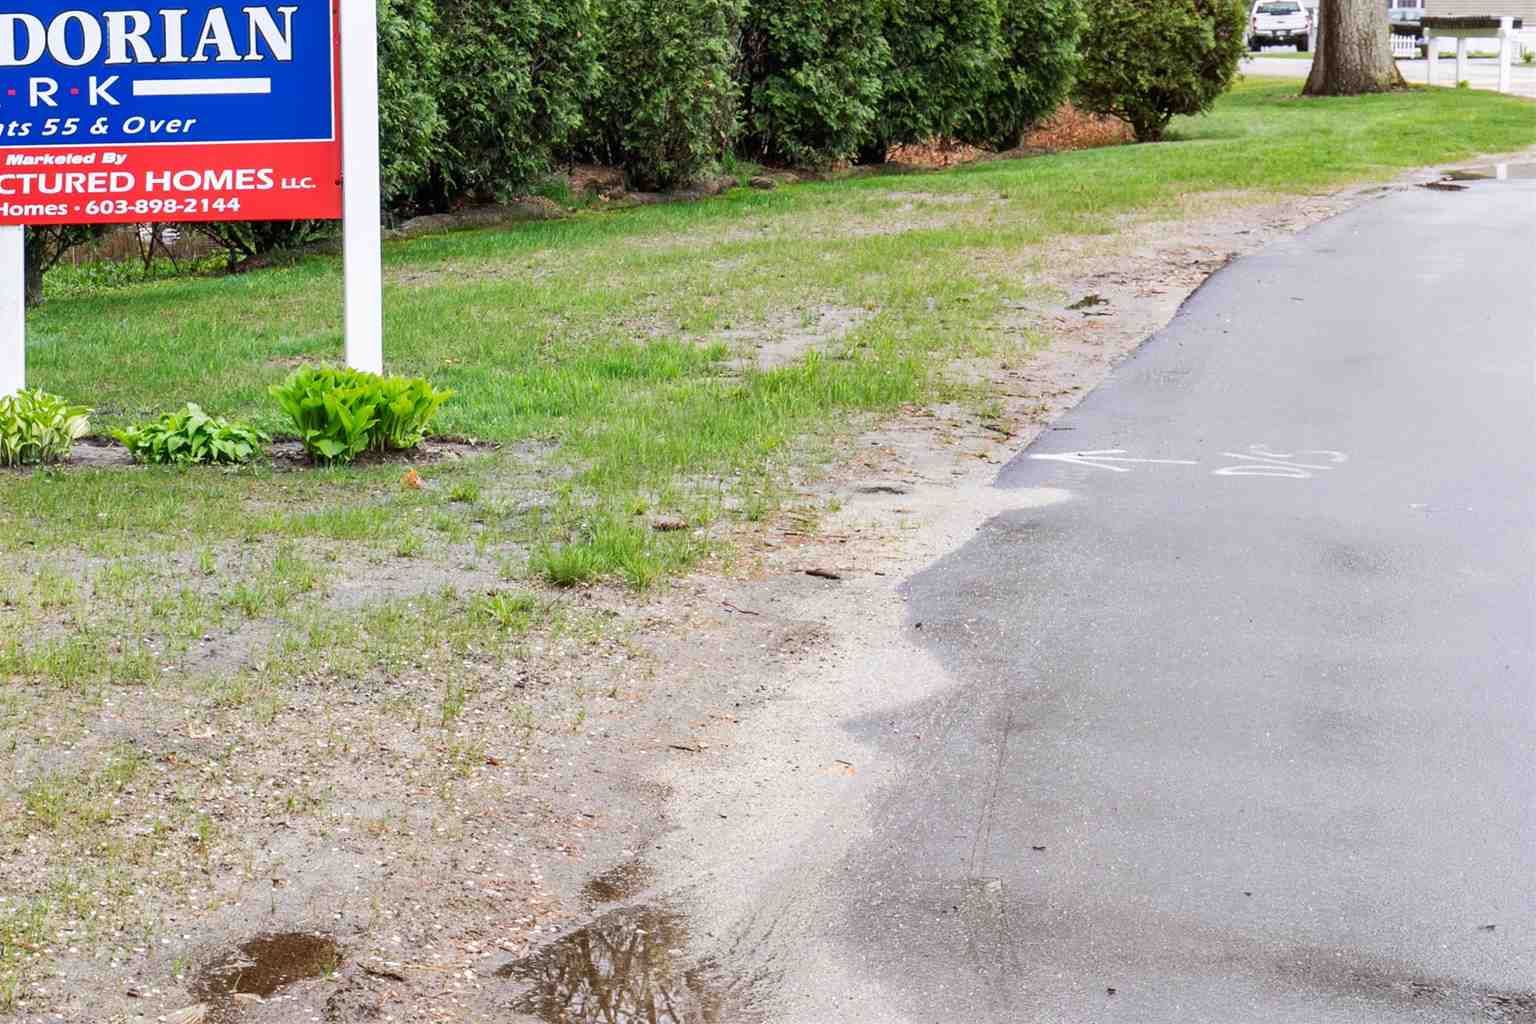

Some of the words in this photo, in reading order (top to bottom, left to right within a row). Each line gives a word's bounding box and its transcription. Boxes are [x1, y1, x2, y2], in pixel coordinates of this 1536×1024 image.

[41, 117, 81, 136] 55
[89, 117, 109, 135] &
[122, 116, 197, 134] Over
[5, 152, 97, 166] Marketed
[101, 151, 128, 166] By
[145, 167, 275, 193] HOMES
[280, 176, 317, 190] LLC.
[85, 197, 241, 215] 603-898-2144
